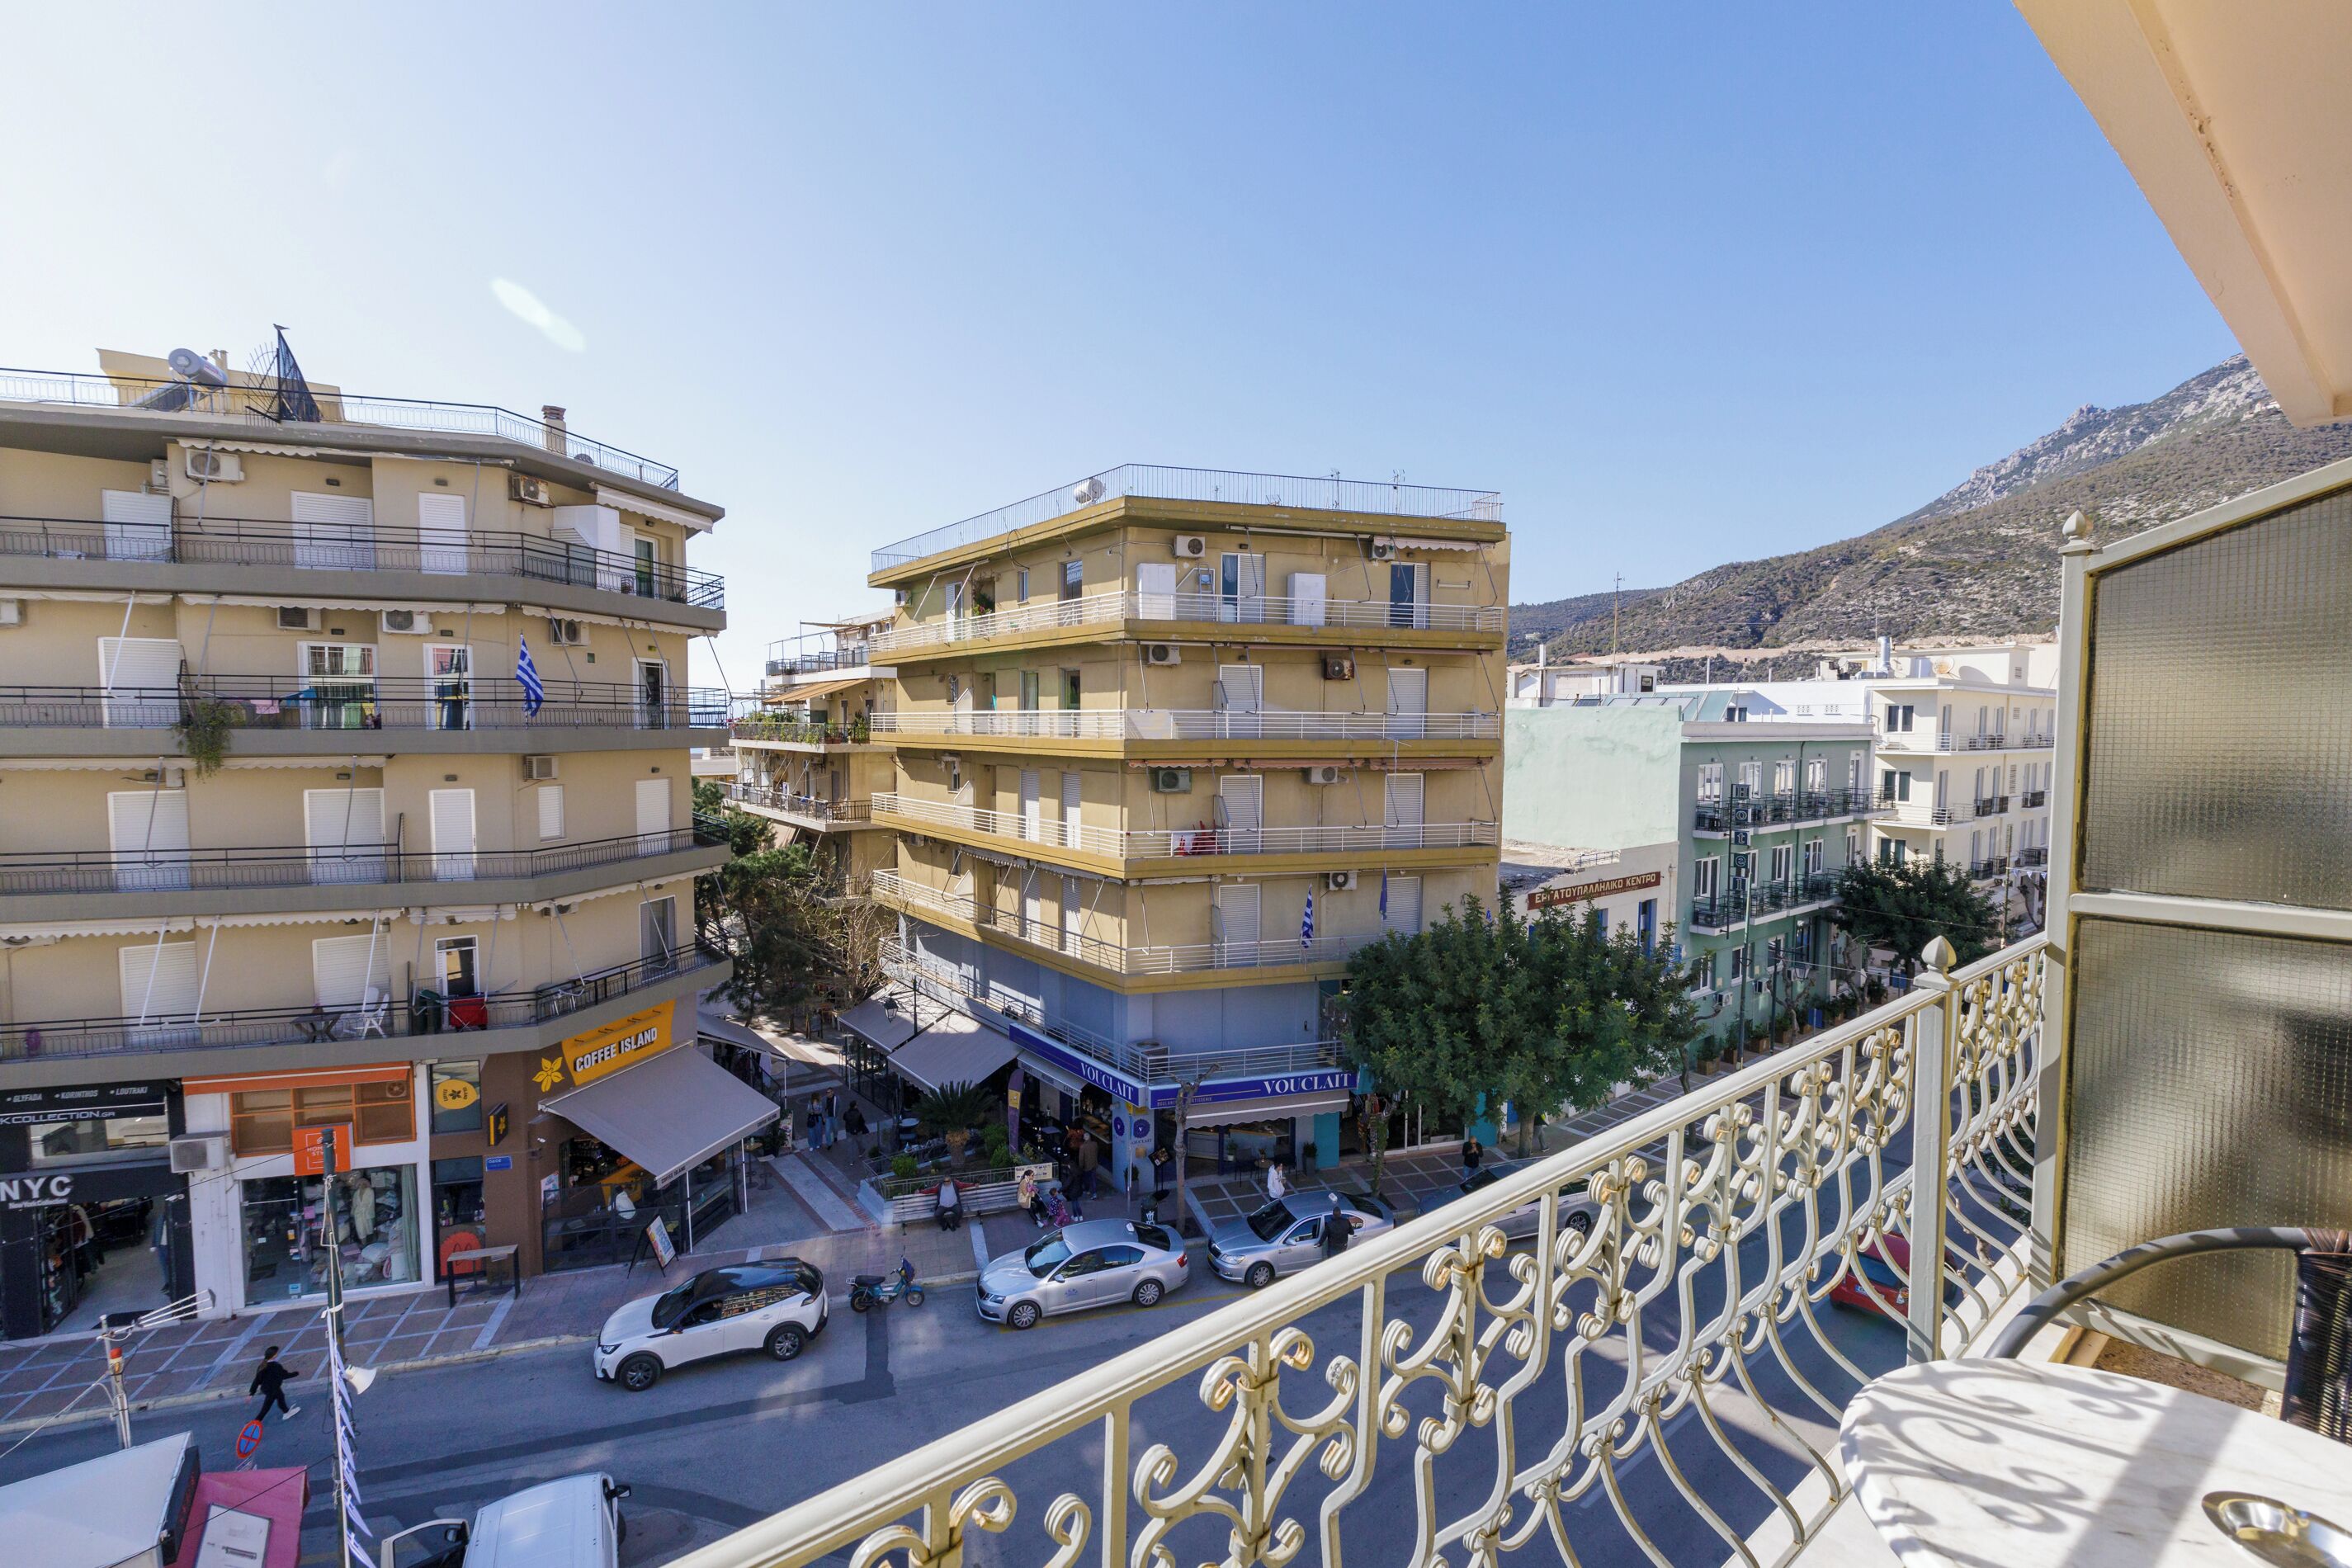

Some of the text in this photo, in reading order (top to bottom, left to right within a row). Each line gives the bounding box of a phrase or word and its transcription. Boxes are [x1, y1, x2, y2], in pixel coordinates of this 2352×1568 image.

[1626, 873, 1656, 887] ΚΕΝΤΡΟ
[574, 1027, 657, 1072] COFFEE ISLAND
[1080, 1062, 1134, 1101] VOUCLAIT
[1263, 1073, 1352, 1094] VOUCLAIT
[13, 1086, 149, 1103] GLYFADA KORINTHOS LOUTRAKI
[0, 1176, 73, 1202] NYC
